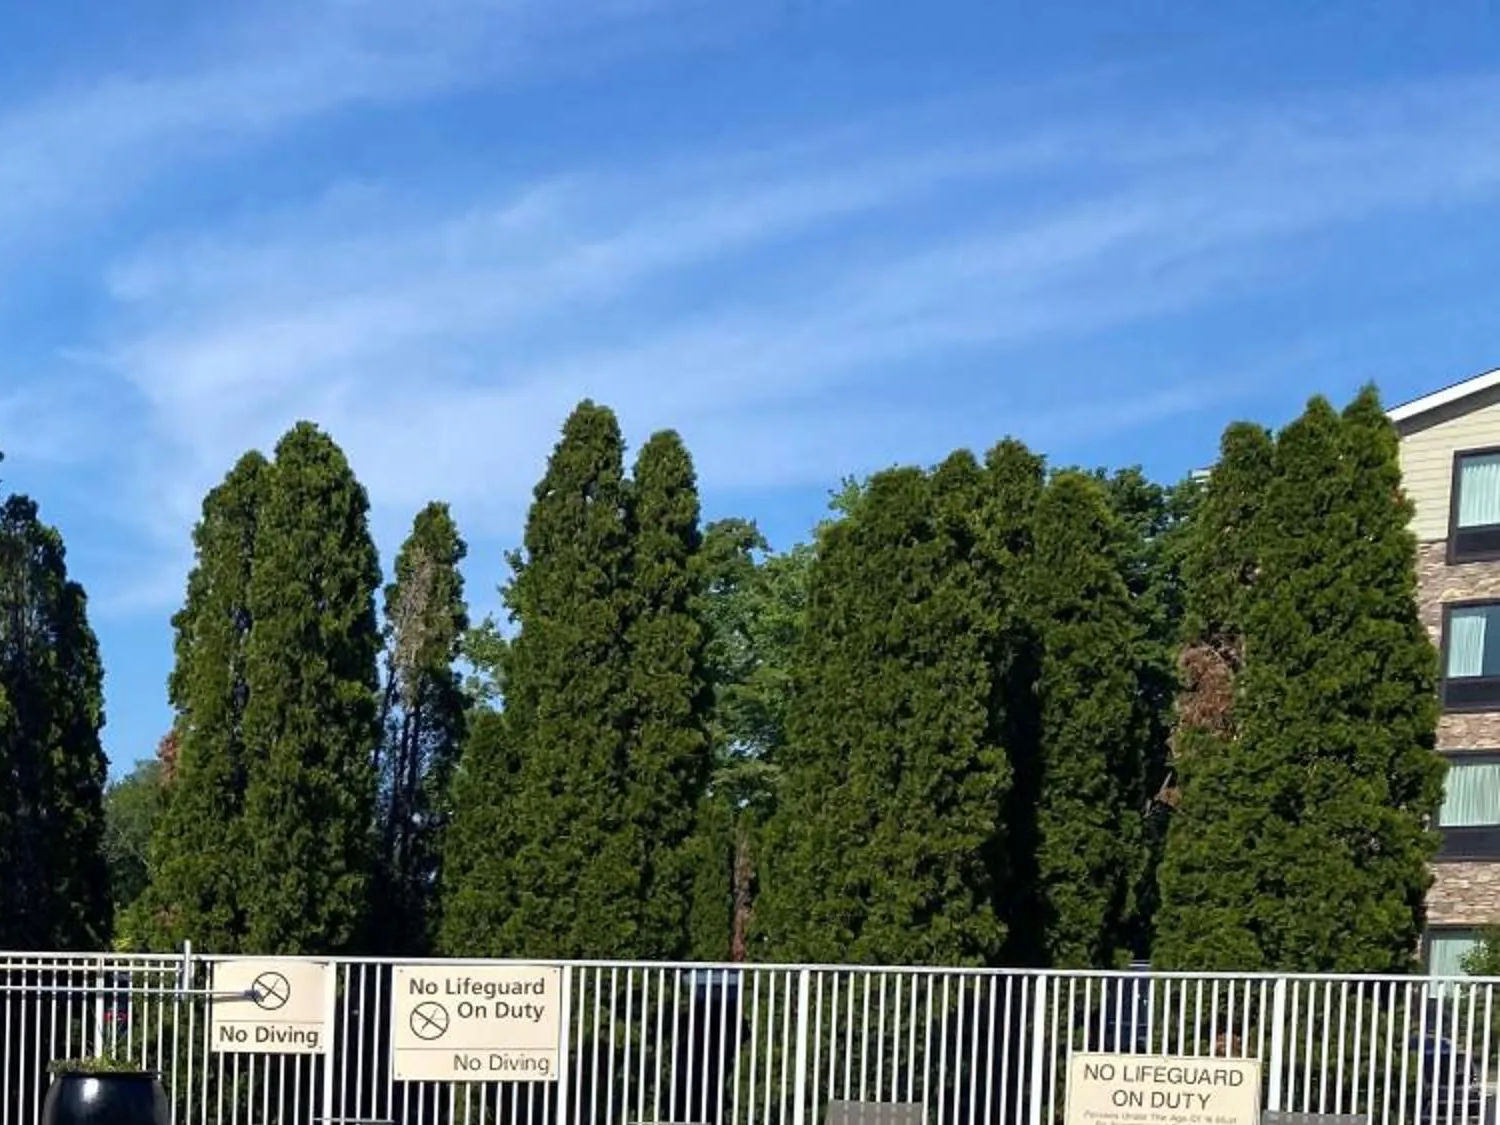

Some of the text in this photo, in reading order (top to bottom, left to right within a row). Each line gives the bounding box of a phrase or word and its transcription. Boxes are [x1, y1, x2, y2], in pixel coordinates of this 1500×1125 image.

[409, 977, 546, 1001] No Lifeguard
[457, 1001, 545, 1023] On Duty
[218, 1025, 320, 1049] No Diving
[453, 1054, 551, 1075] No Diving
[1083, 1063, 1244, 1087] NO LIFEGUARD
[1112, 1089, 1212, 1111] ON DUTY
